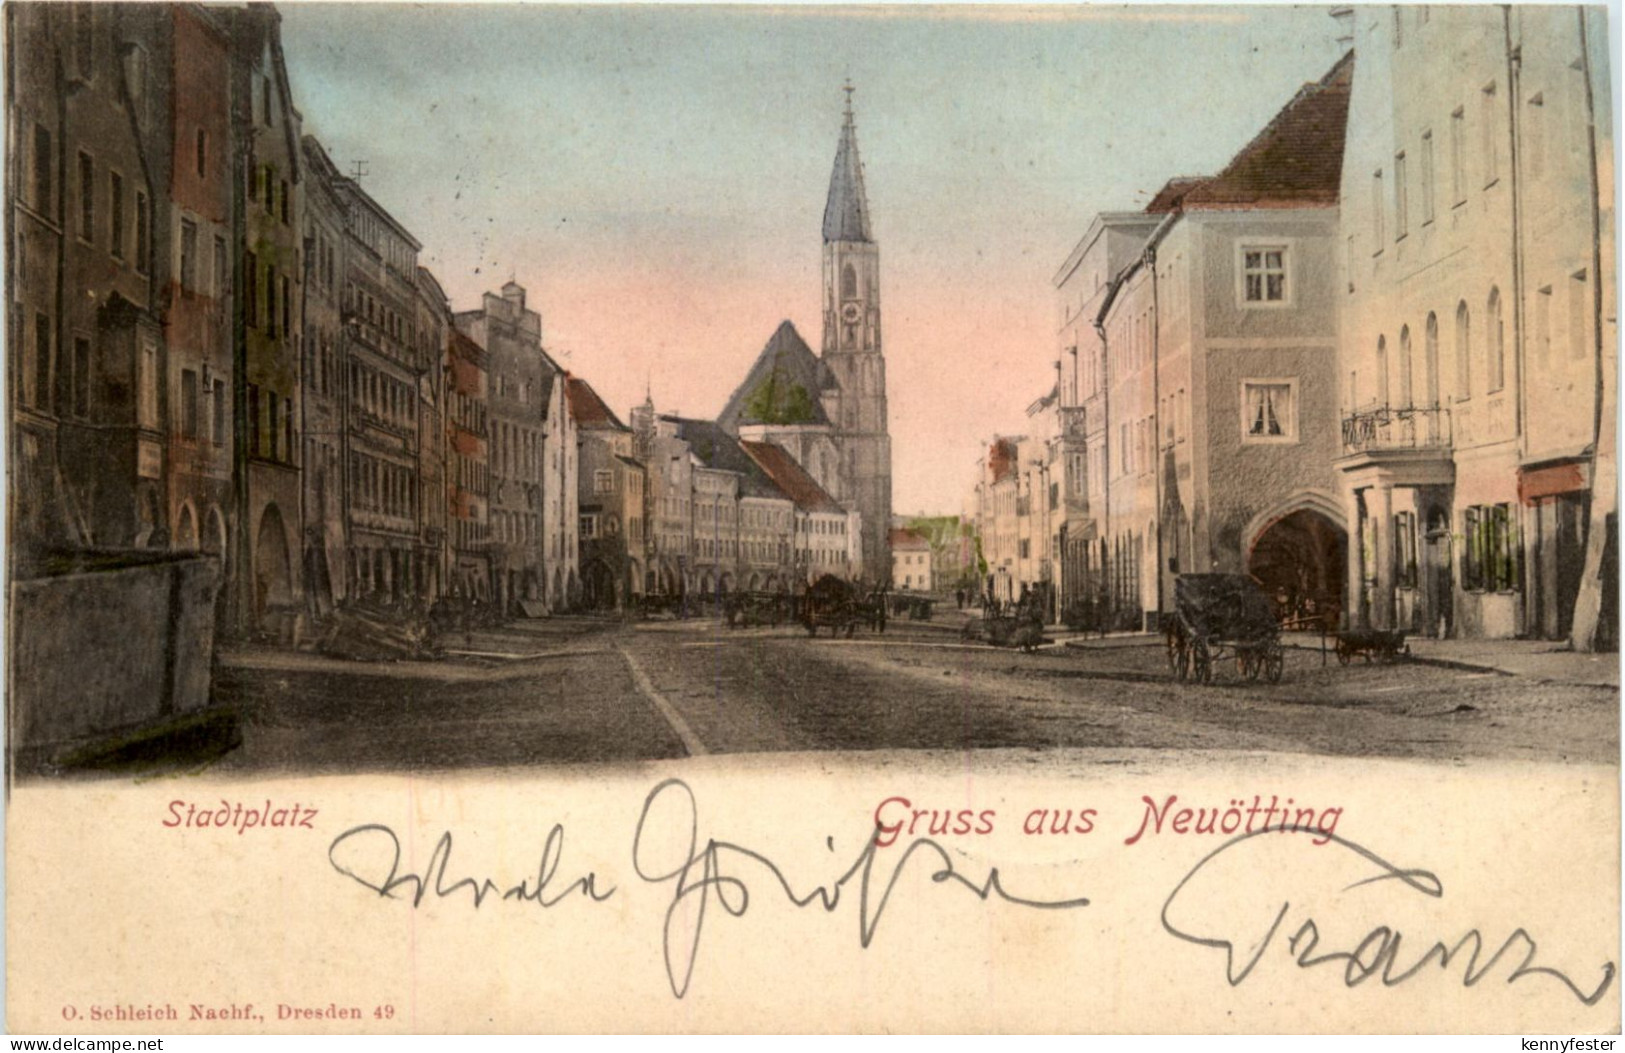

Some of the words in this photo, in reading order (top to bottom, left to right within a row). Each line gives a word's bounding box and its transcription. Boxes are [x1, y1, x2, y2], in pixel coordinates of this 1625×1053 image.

[162, 799, 318, 834] Stadtplatz
[874, 796, 995, 847] Gruss
[1022, 809, 1097, 835] aus
[1125, 796, 1344, 845] Neuötting
[61, 1005, 84, 1021] O.
[90, 1004, 178, 1021] Schleich
[189, 1004, 265, 1023] Nachf.,
[277, 1004, 363, 1021] Dresden
[373, 1005, 395, 1021] 49
